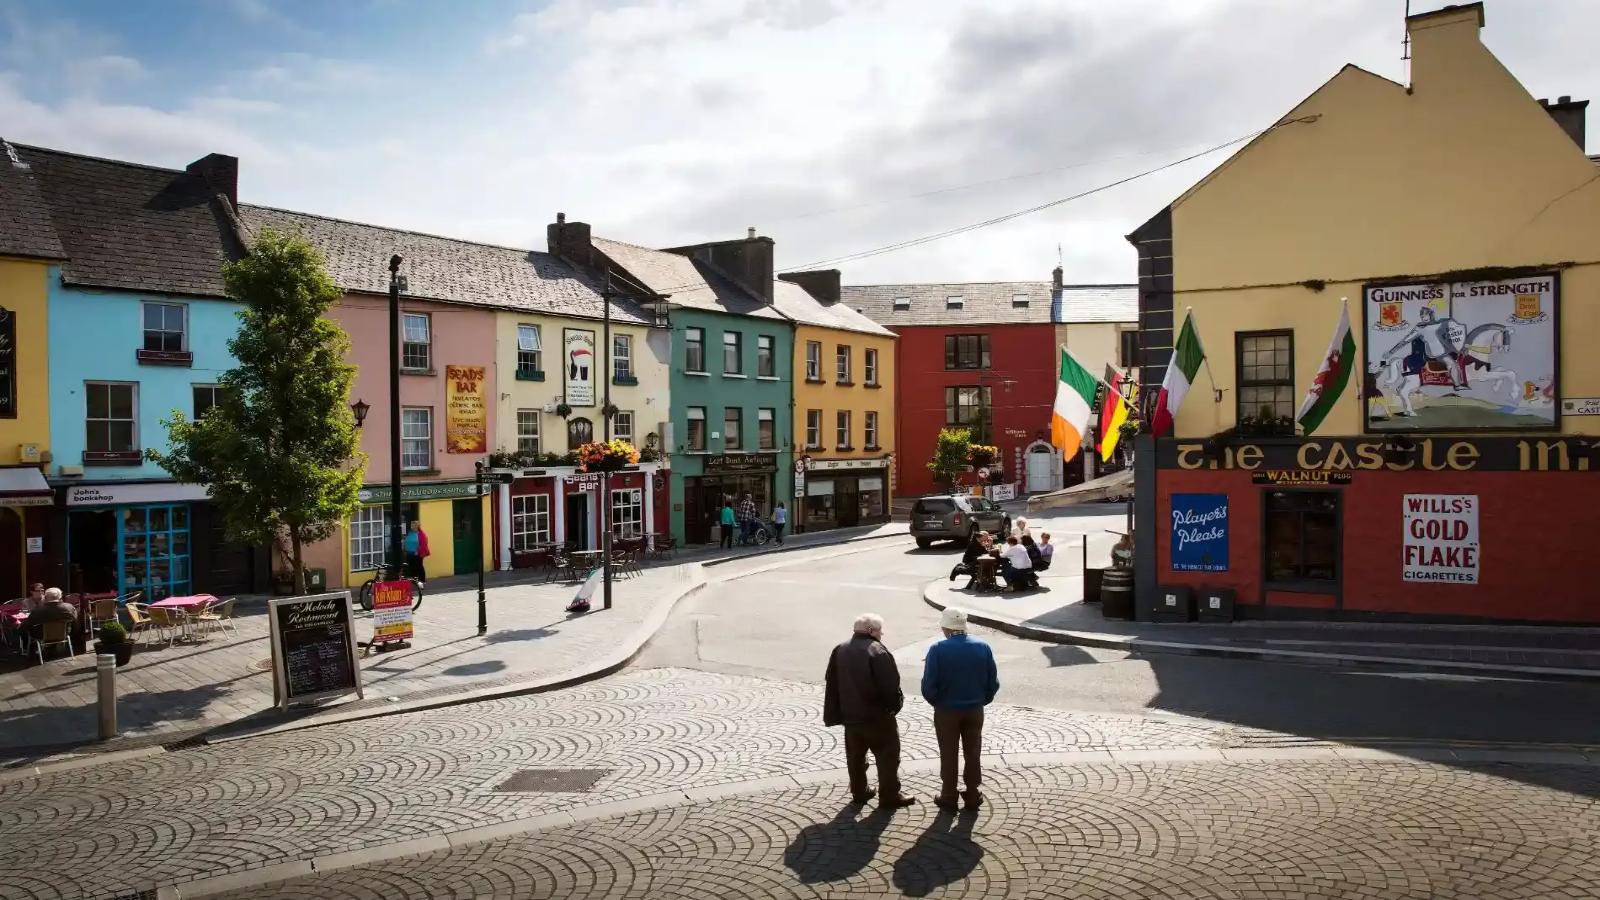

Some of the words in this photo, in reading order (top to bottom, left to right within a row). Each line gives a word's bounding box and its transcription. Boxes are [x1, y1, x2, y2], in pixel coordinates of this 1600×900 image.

[1371, 287, 1444, 303] GUINNESS
[1470, 282, 1550, 297] STRENGTH
[455, 381, 477, 393] BAR
[1266, 471, 1331, 481] WALNUT
[578, 482, 599, 493] Bar
[1172, 506, 1227, 531] Player's
[1178, 527, 1225, 552] Please
